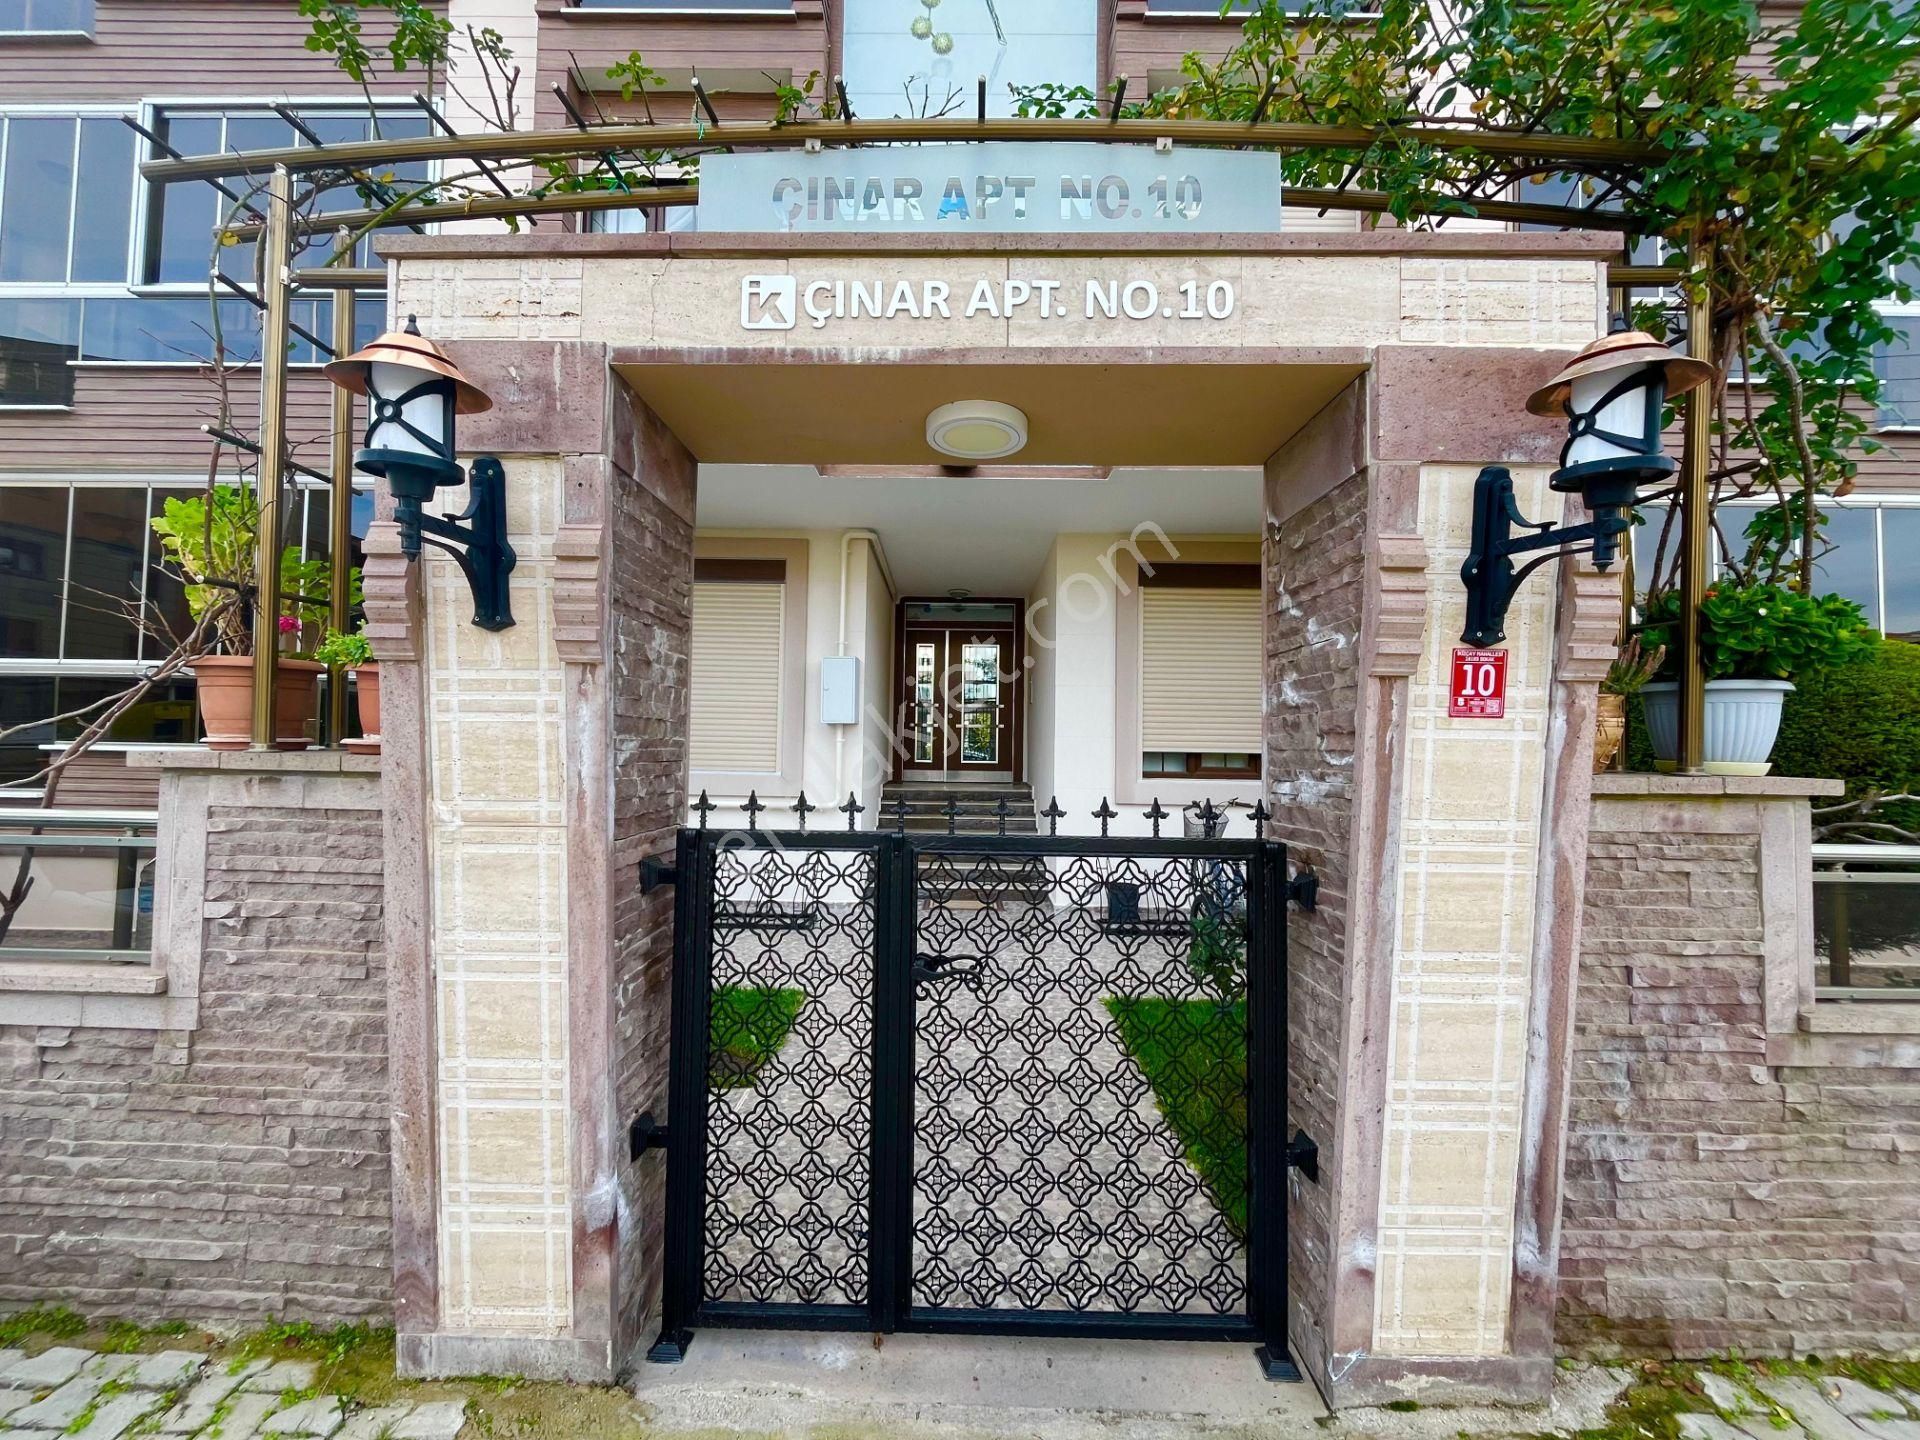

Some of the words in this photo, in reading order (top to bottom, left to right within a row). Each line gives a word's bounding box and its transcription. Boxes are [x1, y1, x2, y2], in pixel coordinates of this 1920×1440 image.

[771, 175, 923, 232] ÇINAR
[937, 175, 1036, 220] APT
[803, 279, 951, 329] ÇINAR
[964, 279, 1067, 318] APT.
[1085, 279, 1235, 320] NO.10
[1461, 664, 1496, 697] 10
